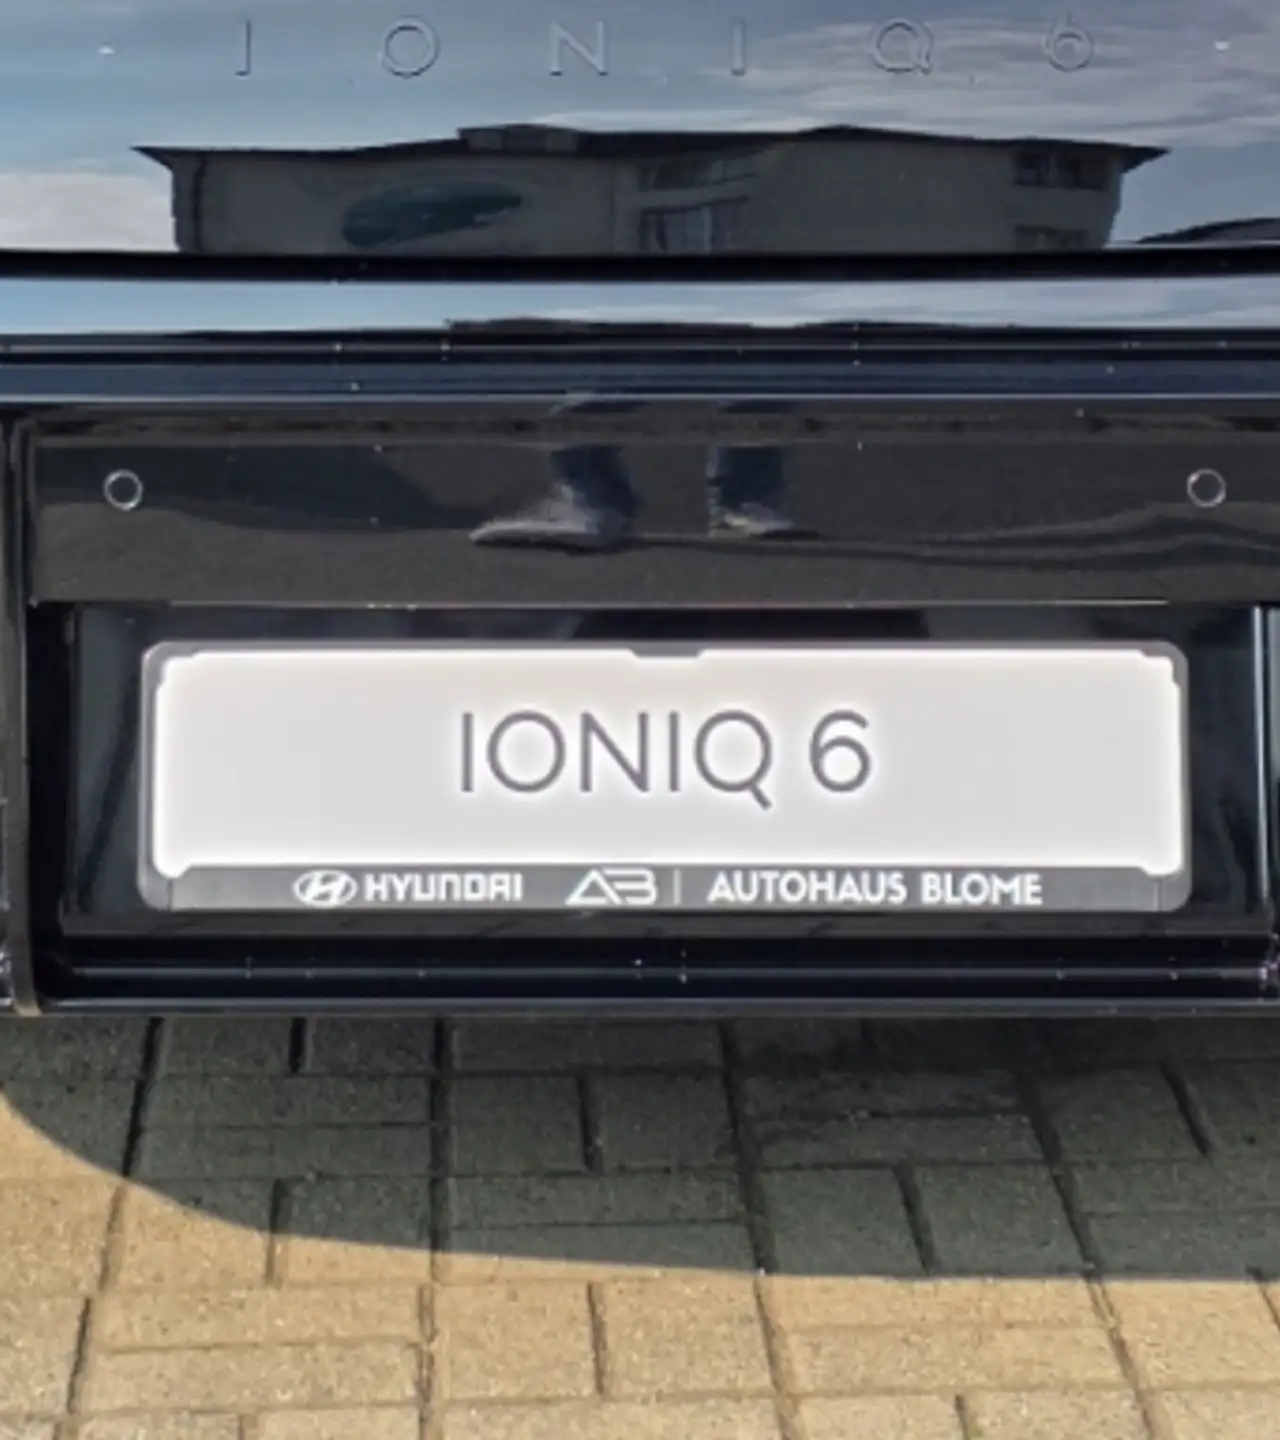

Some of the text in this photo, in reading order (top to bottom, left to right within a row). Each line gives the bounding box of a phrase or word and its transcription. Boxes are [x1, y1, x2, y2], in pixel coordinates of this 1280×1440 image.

[460, 709, 872, 811] IONIQ 6
[364, 872, 524, 902] HYUNDAI
[707, 870, 909, 904] AUTOHAUS
[920, 872, 1043, 906] BLOME
